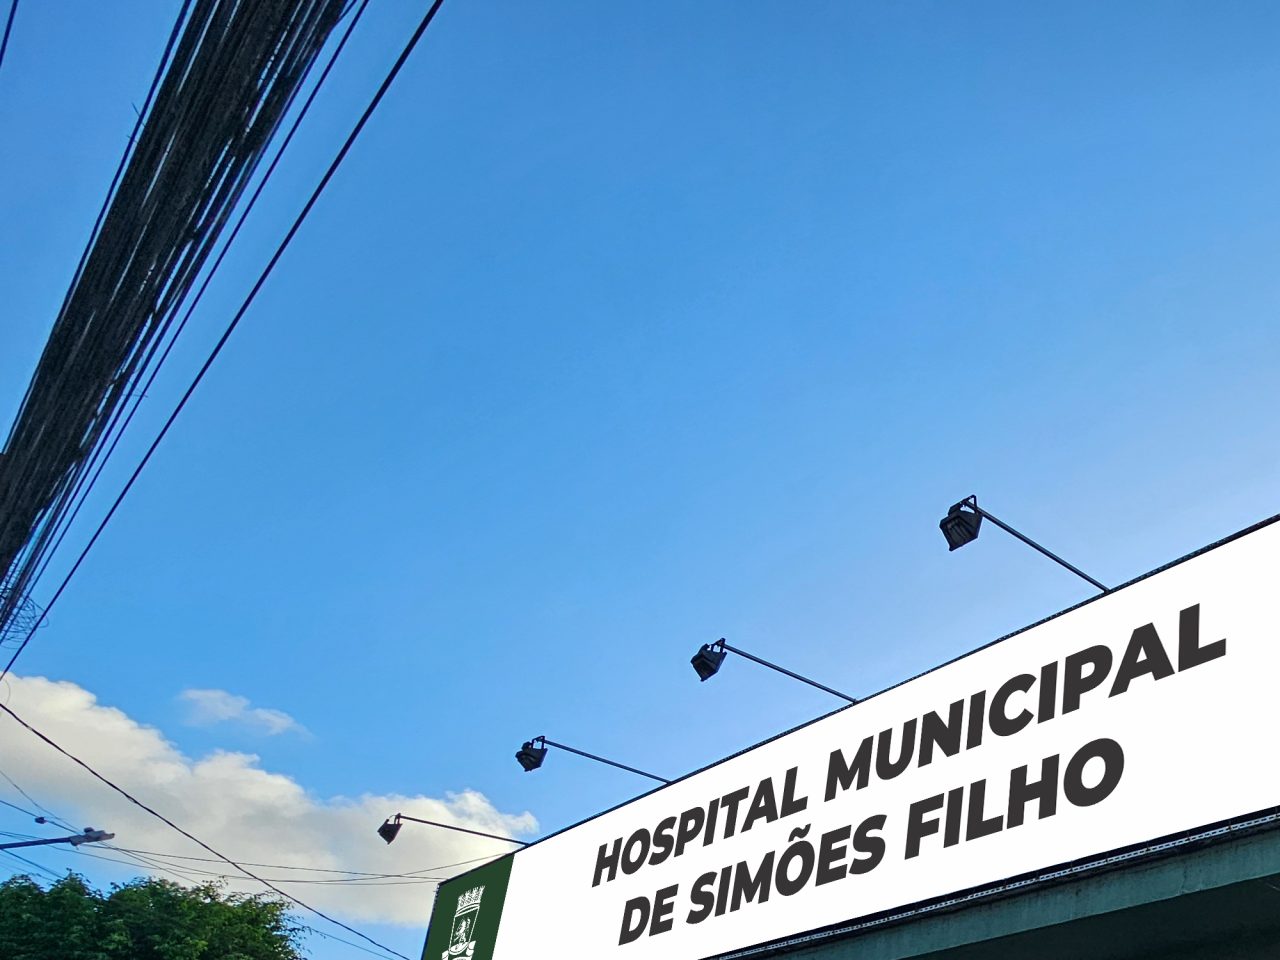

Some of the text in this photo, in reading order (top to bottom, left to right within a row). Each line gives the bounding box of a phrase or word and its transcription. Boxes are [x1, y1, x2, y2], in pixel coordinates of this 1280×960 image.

[591, 602, 1227, 888] HOSPITAL MUNICIPAL
[617, 737, 1125, 947] DE SIMÕES FILHO
